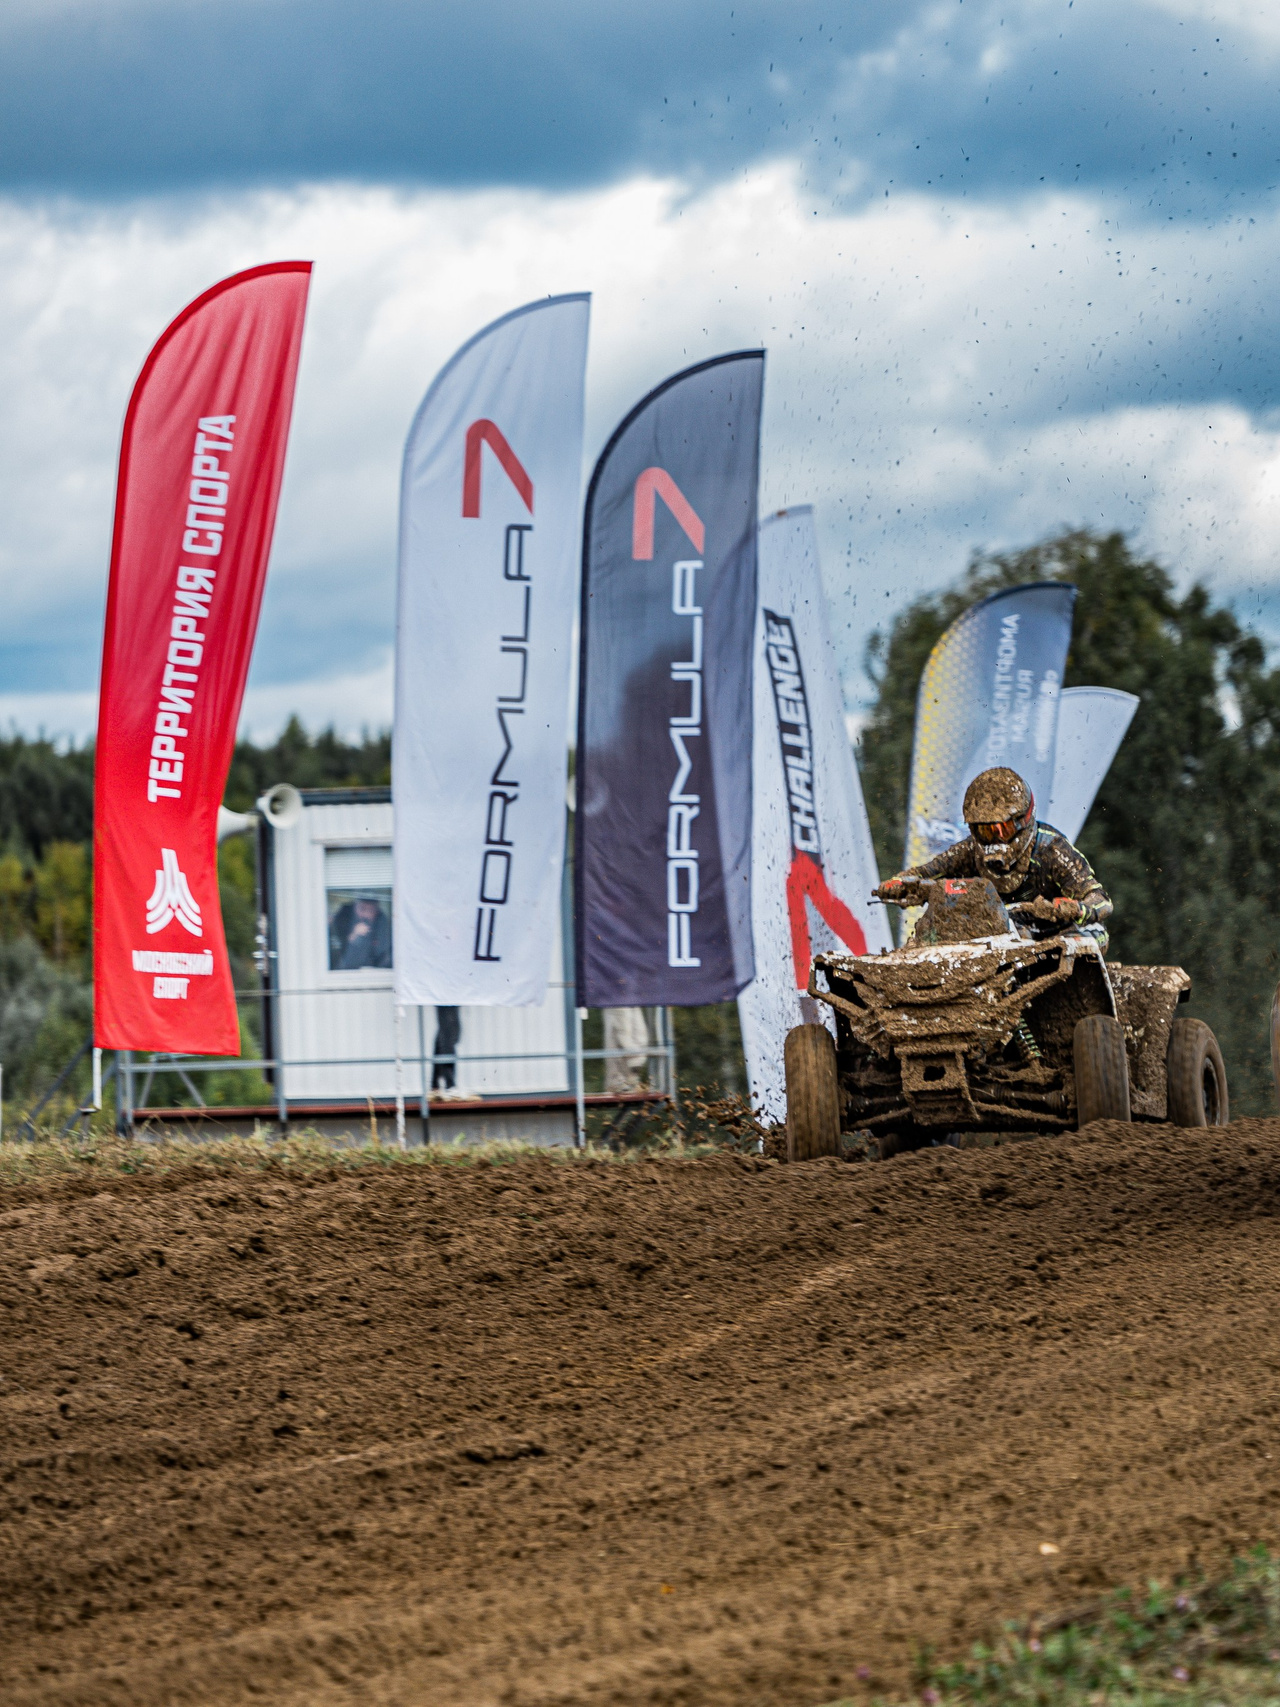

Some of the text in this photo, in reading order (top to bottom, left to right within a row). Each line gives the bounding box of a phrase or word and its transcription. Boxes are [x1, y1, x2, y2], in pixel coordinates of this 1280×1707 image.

[147, 414, 237, 803] ТЕРРИТОРИЯ СПОРТА
[473, 523, 533, 962] FORMULA
[667, 560, 704, 967] FORMULA
[765, 614, 820, 855] CHALLENGE
